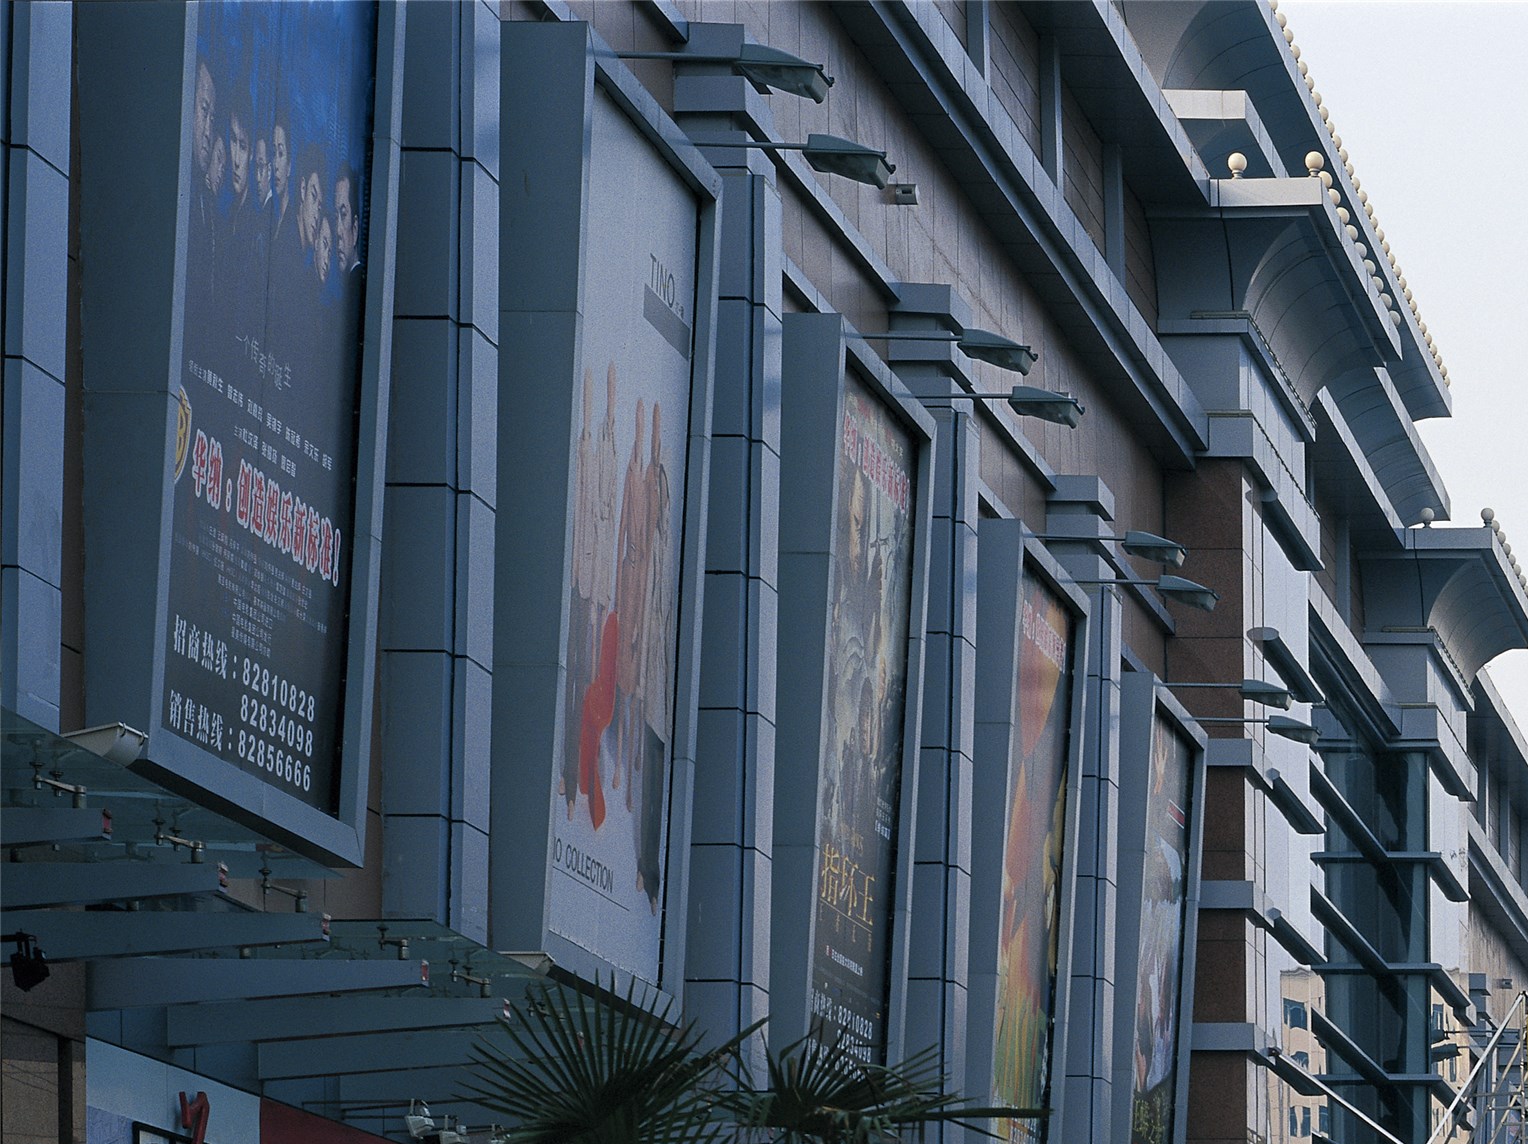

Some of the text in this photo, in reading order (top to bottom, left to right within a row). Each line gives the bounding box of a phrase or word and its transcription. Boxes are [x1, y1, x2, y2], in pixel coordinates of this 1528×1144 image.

[650, 253, 675, 308] TINO
[240, 694, 314, 757] 82834098
[565, 844, 614, 893] COLLECTION
[821, 843, 876, 926] 指环王
